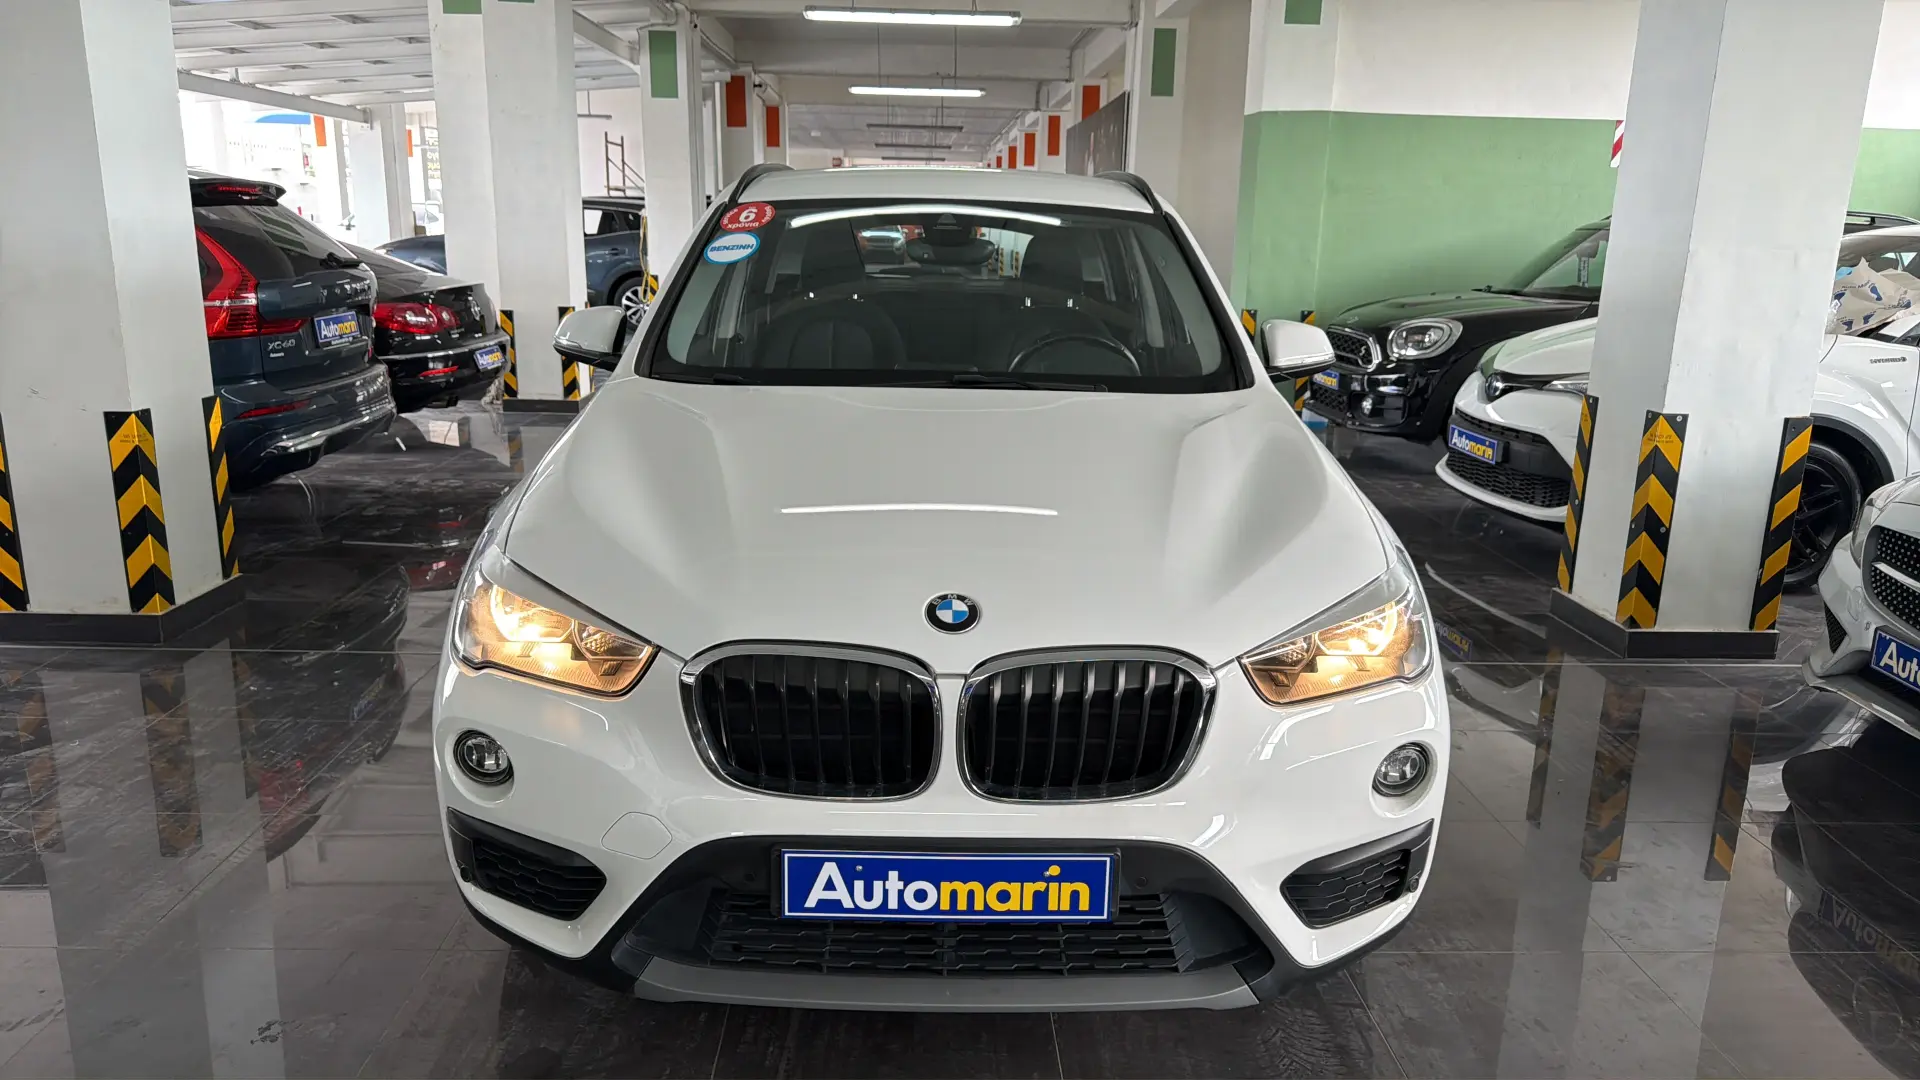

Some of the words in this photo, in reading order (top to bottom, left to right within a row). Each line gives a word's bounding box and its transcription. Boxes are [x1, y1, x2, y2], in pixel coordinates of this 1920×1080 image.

[739, 208, 757, 223] 6
[1451, 429, 1494, 460] Automarin
[931, 593, 975, 606] BMW
[1880, 641, 1920, 686] Aut
[803, 861, 1091, 911] Automarin
